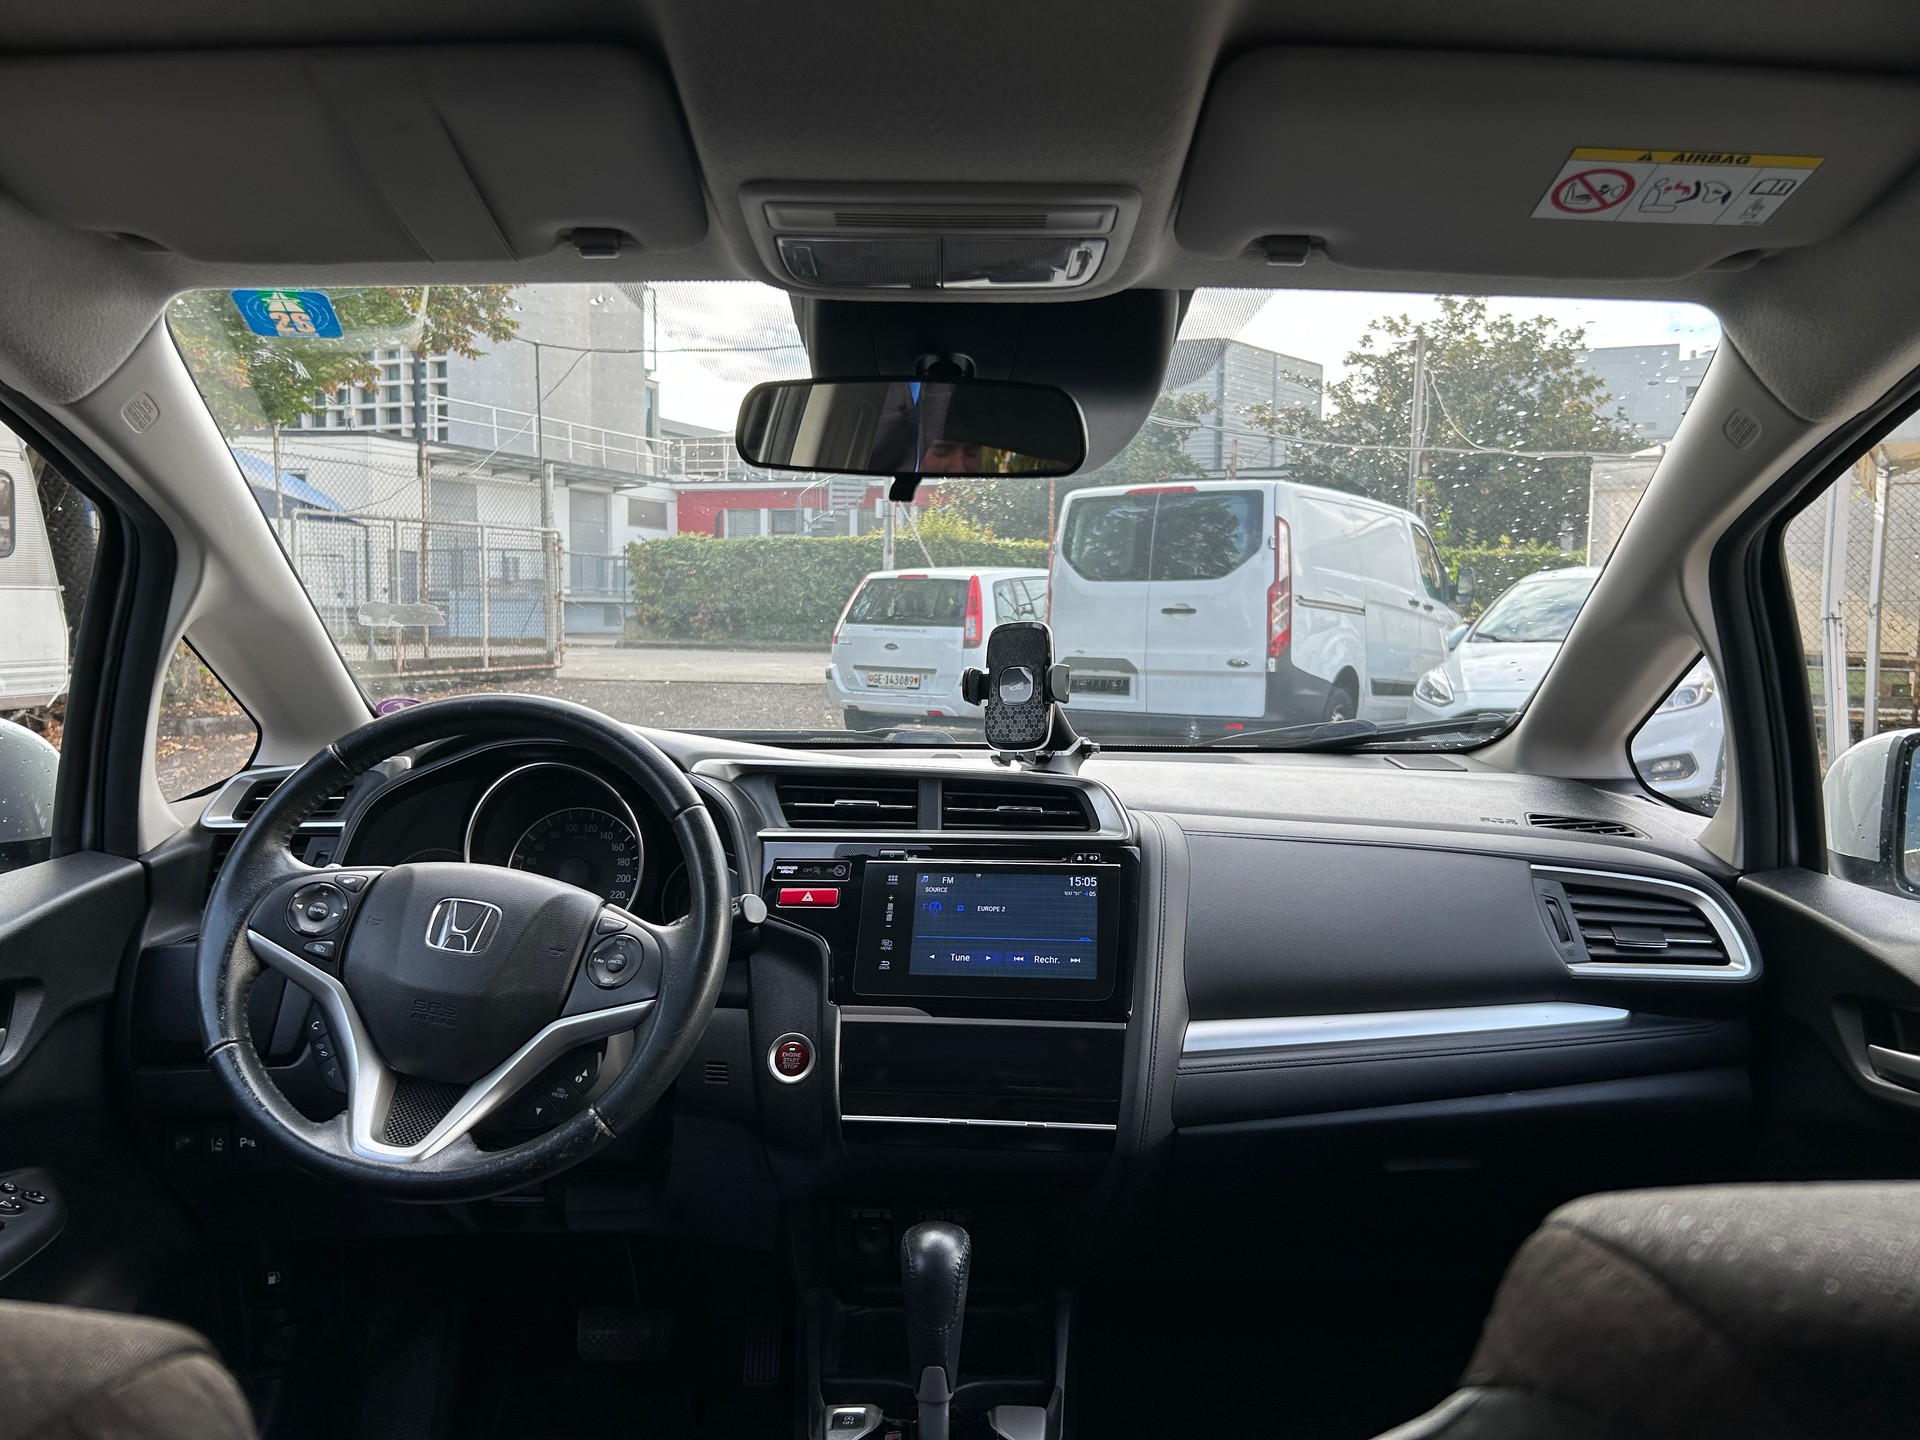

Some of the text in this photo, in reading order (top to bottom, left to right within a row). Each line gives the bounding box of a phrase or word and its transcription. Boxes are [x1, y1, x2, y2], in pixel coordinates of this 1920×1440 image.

[1671, 152, 1750, 165] AIRBAG
[565, 823, 579, 832] 100
[584, 824, 598, 833] 120
[549, 831, 559, 839] 80
[600, 831, 613, 840] 140
[534, 843, 545, 851] 60
[611, 843, 625, 852] 160
[526, 857, 537, 865] 40
[617, 858, 630, 867] 180
[615, 874, 631, 883] 200
[942, 876, 954, 884] FM
[1069, 876, 1097, 887] 15:05
[610, 890, 626, 899] 220
[1001, 905, 1006, 913] 2
[950, 953, 971, 962] Tune
[1034, 955, 1060, 964] Rechr.
[551, 1091, 569, 1099] RESET
